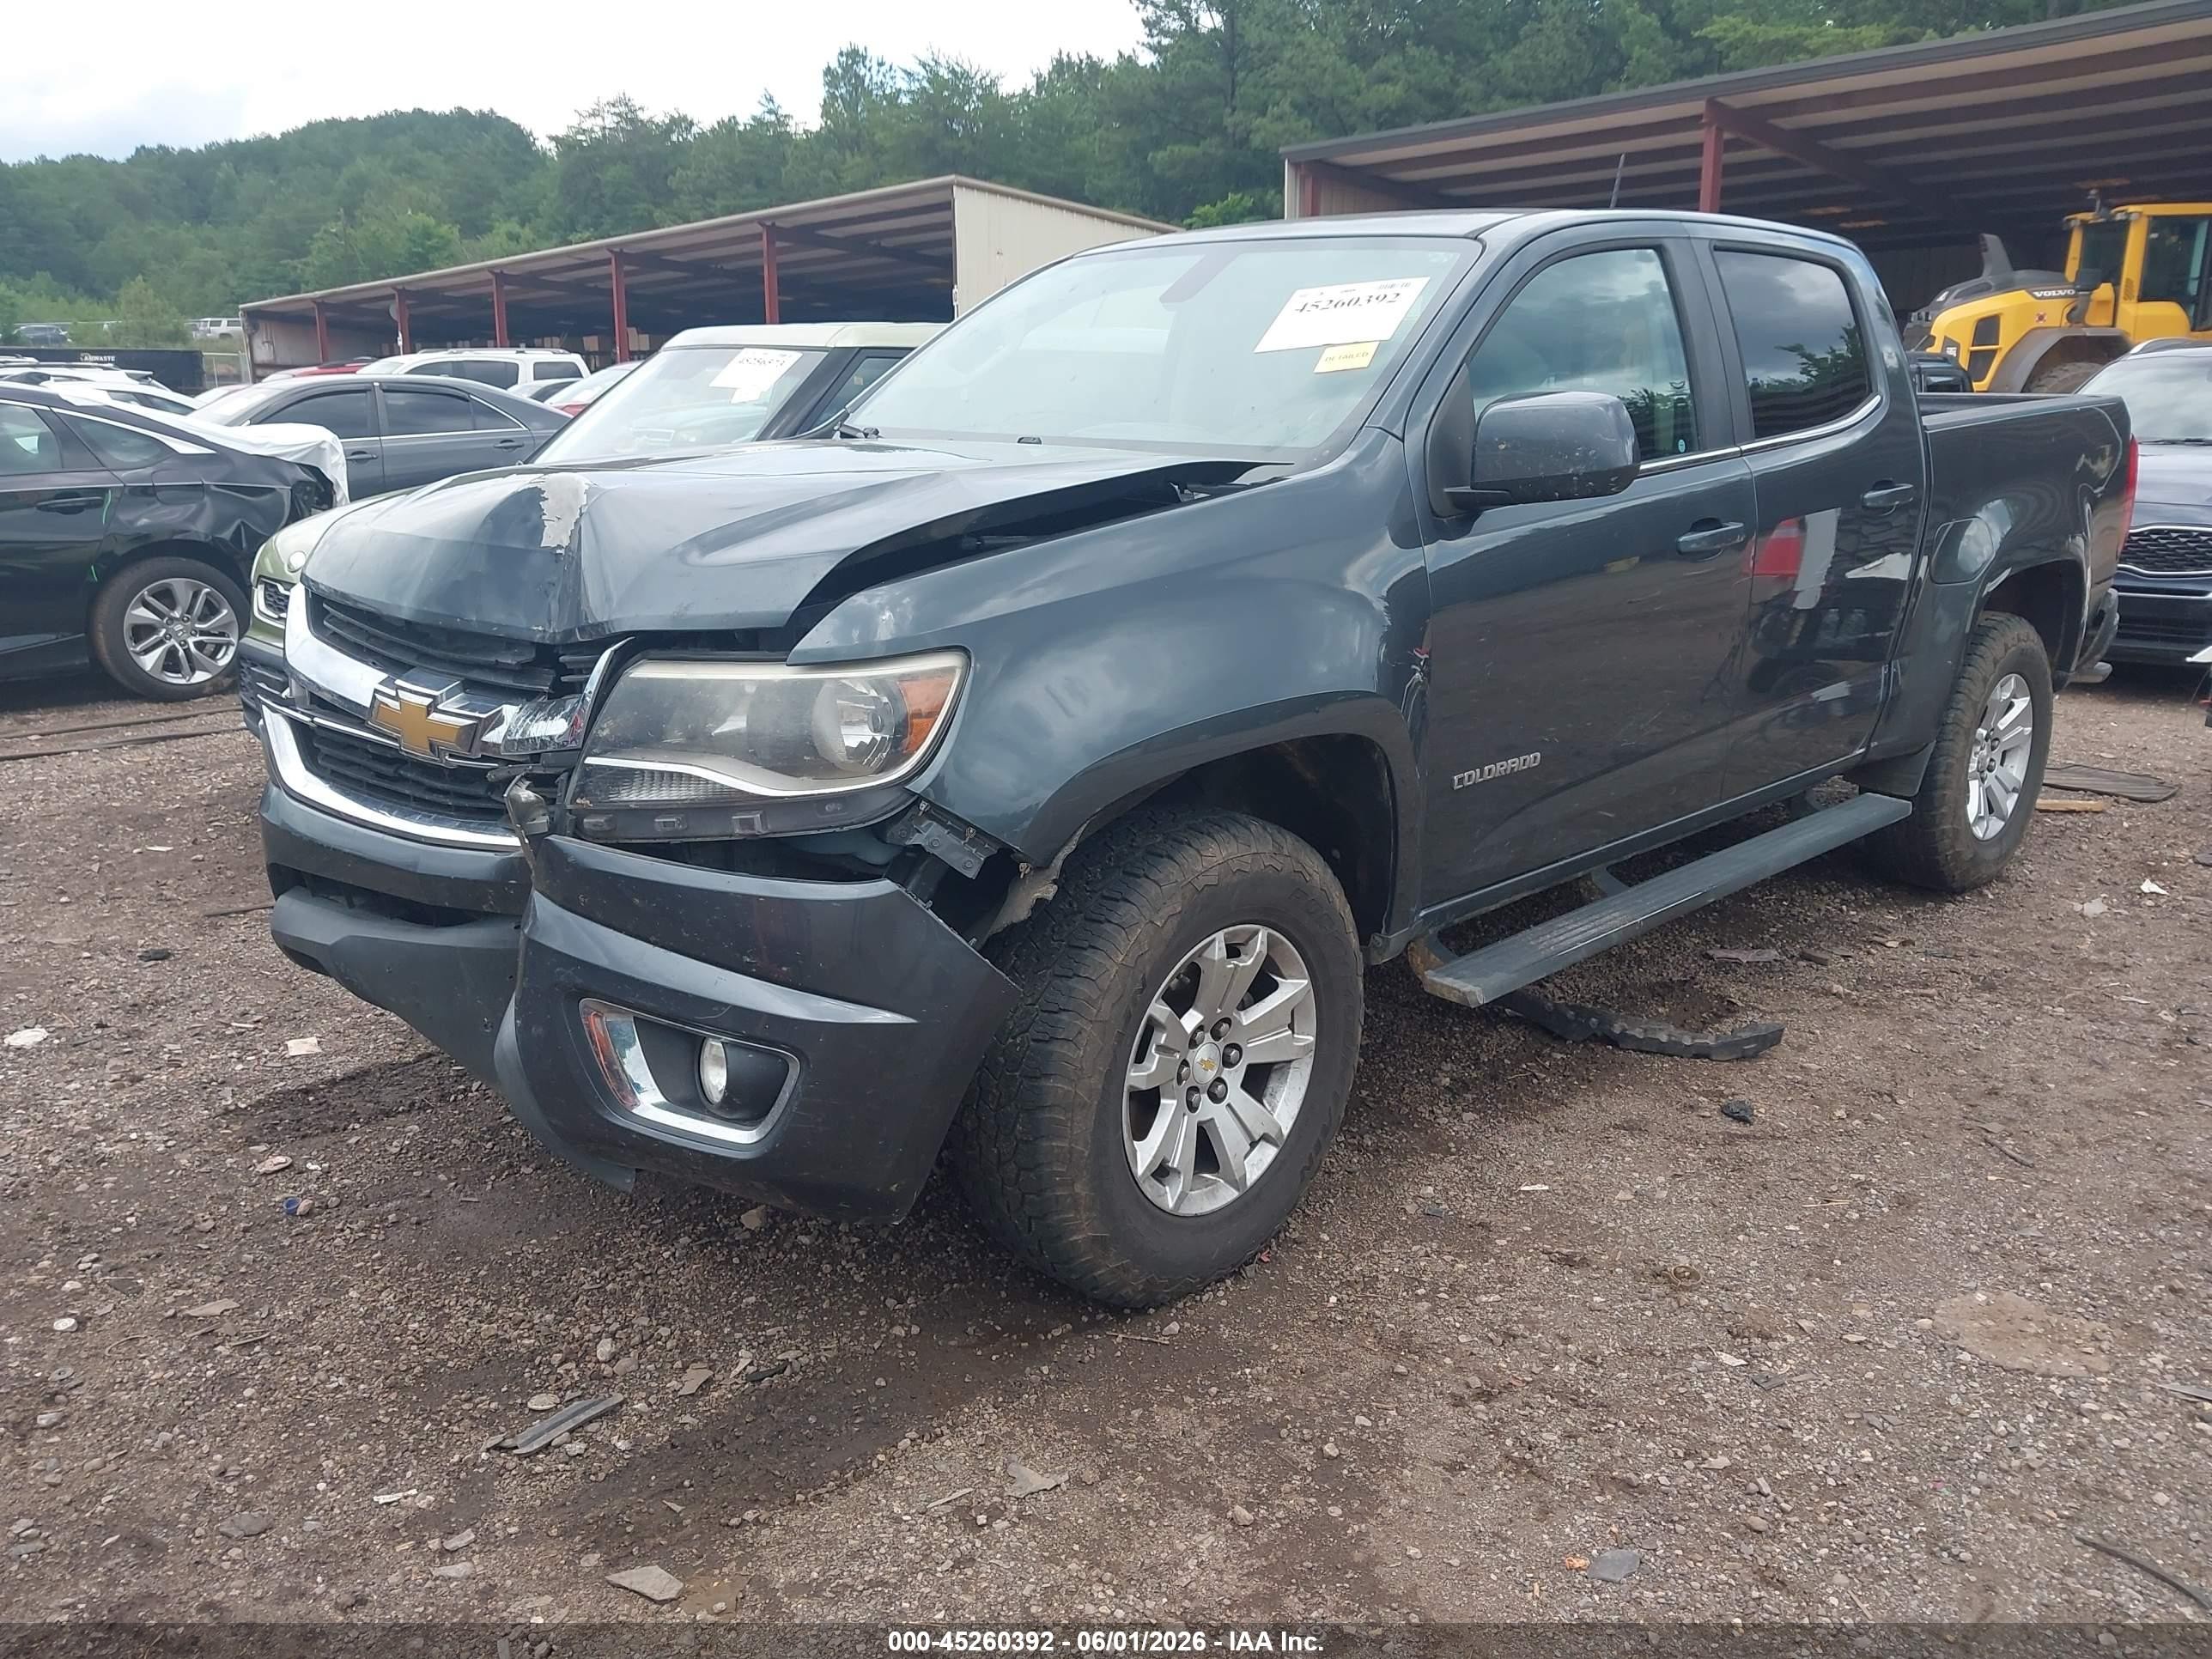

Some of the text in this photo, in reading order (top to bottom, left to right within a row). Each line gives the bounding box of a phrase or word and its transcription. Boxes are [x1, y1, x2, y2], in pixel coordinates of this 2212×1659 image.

[1294, 292, 1401, 313] 45260392
[2033, 289, 2075, 298] VOLVO
[1452, 751, 1542, 791] COLORADO
